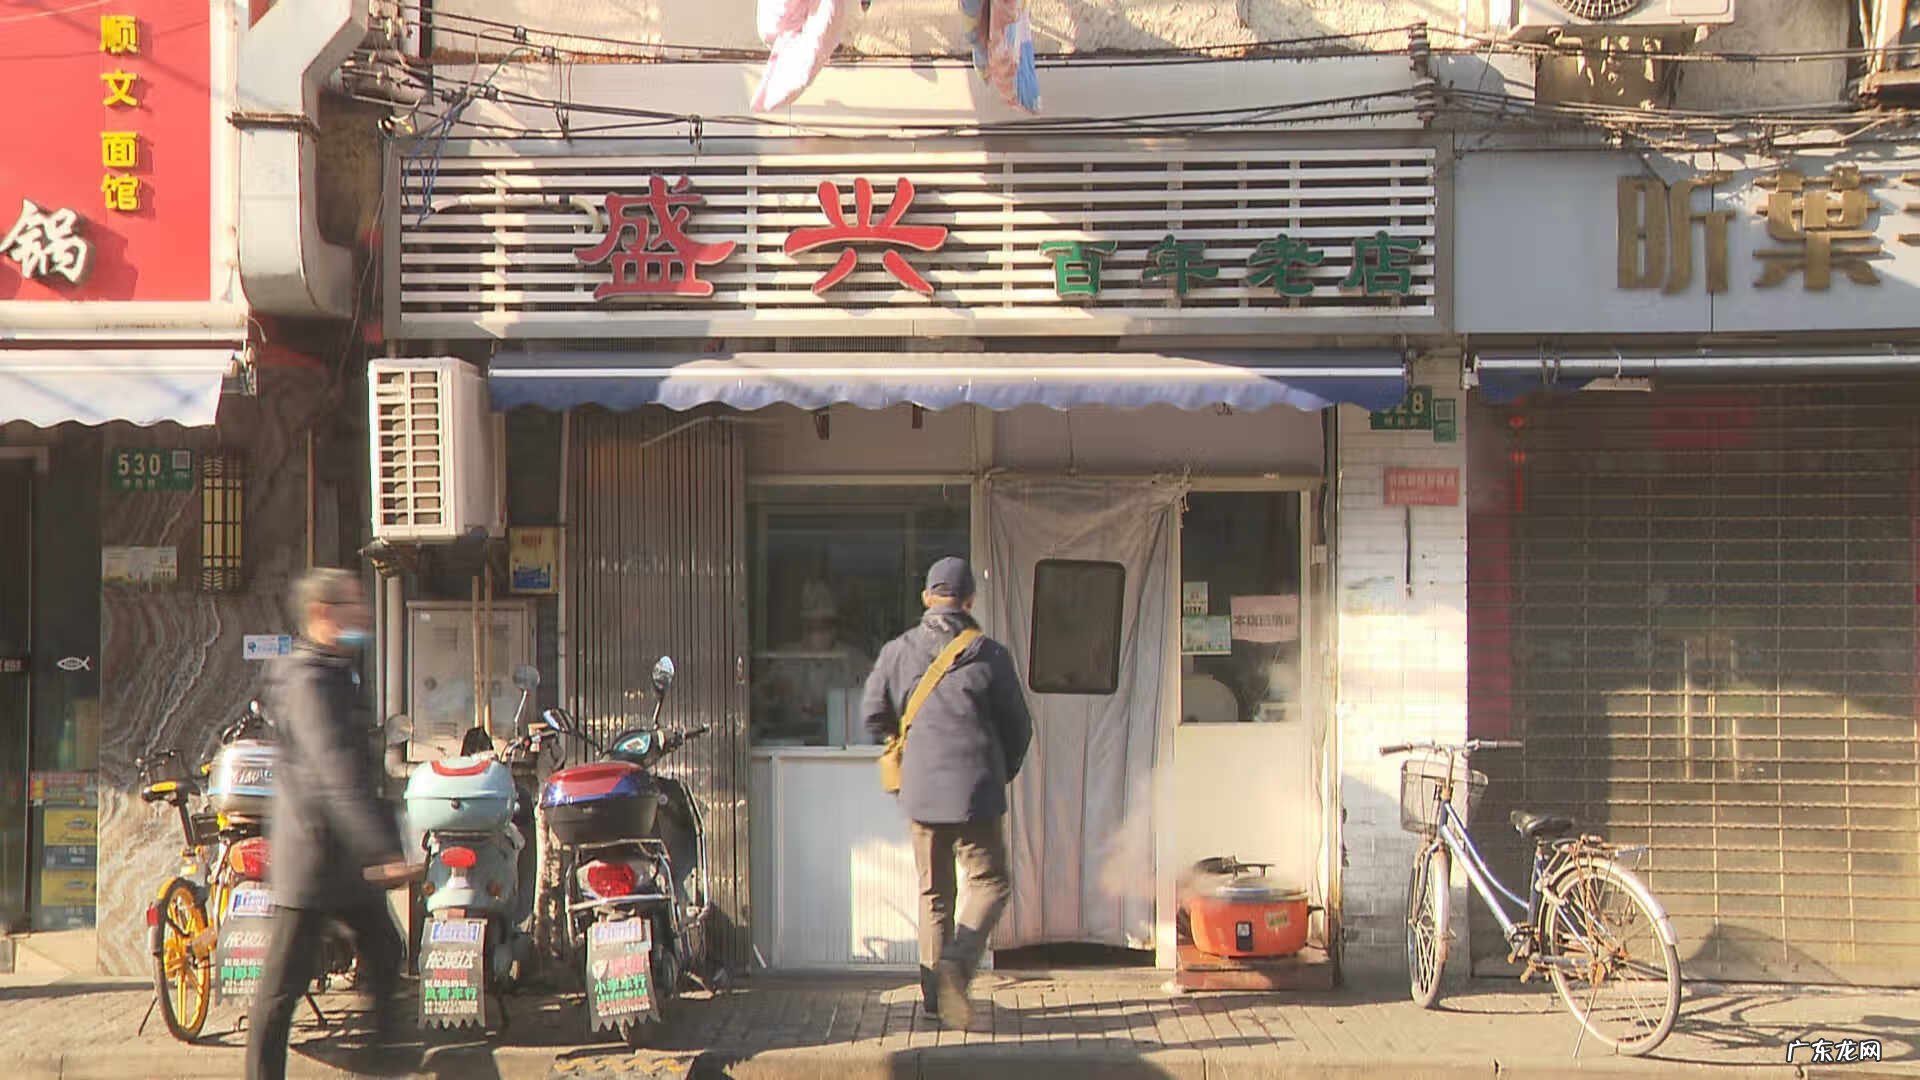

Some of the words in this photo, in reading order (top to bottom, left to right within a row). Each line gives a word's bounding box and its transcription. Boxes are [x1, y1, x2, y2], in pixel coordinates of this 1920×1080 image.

[100, 15, 141, 211] 顺文面馆
[0, 198, 88, 283] 锅
[573, 173, 949, 299] 盛兴
[1039, 230, 1422, 297] 百年老店
[1617, 166, 1920, 294] 昕葉
[117, 453, 161, 477] 530
